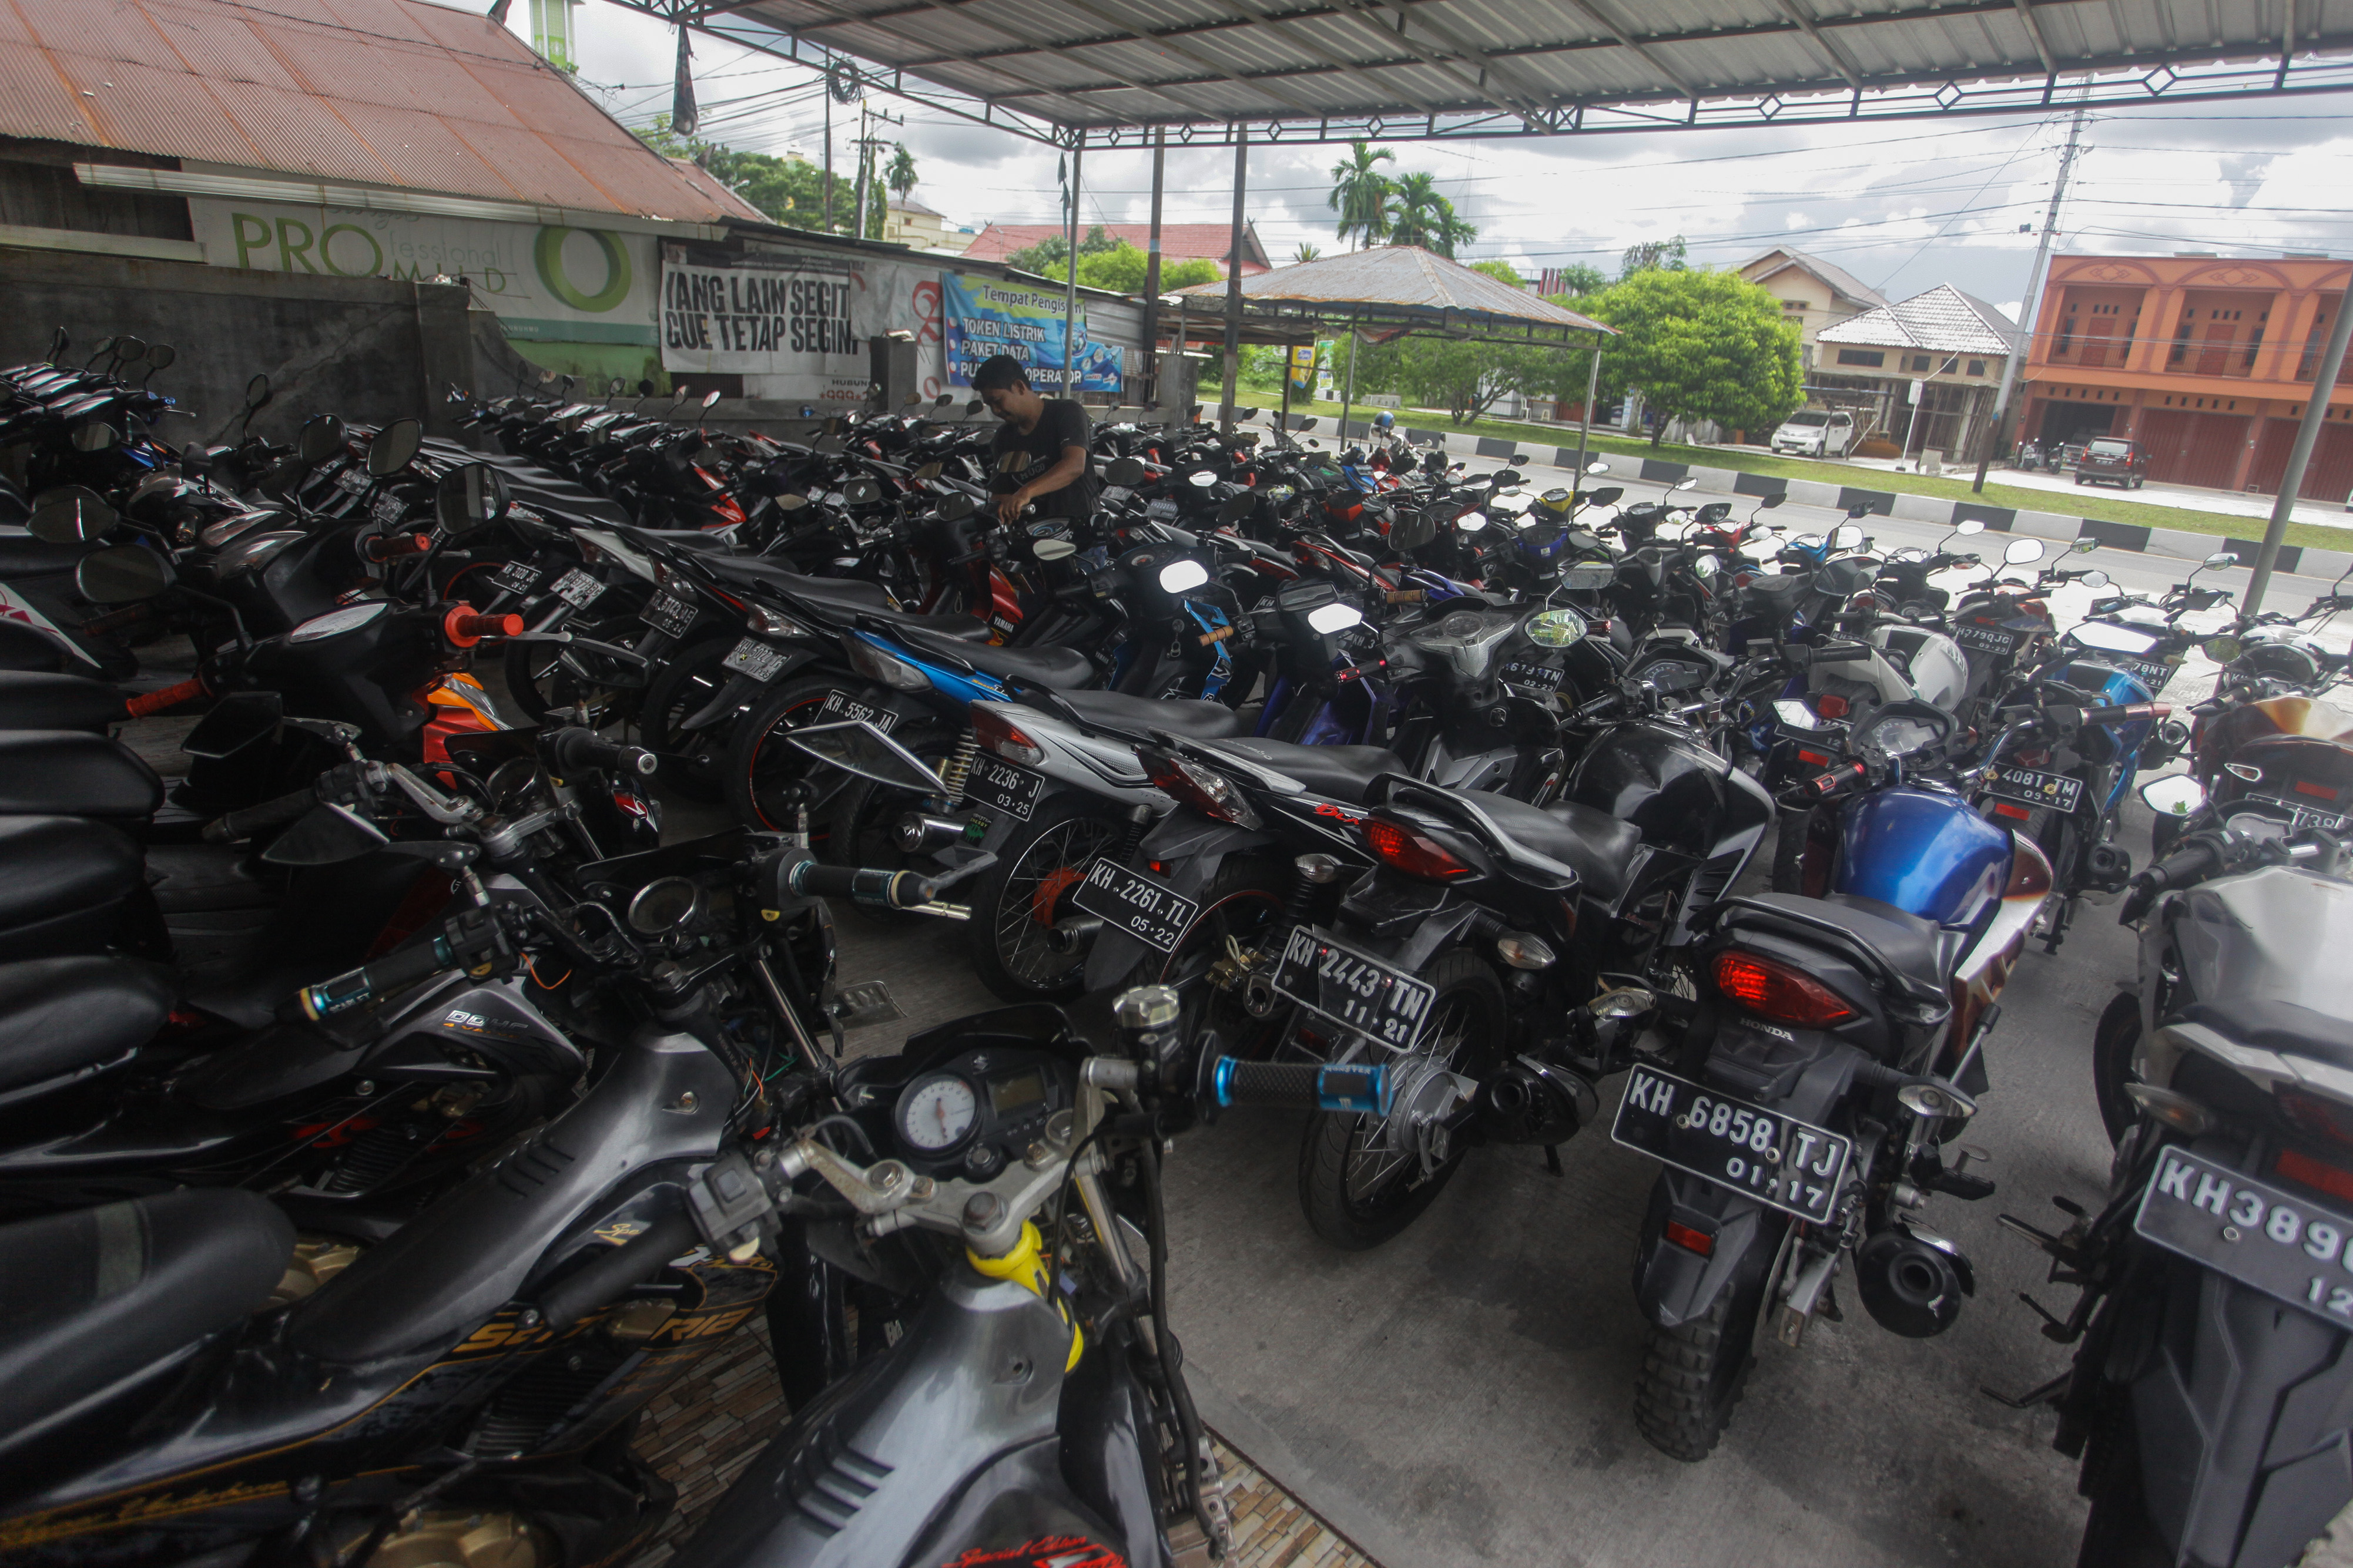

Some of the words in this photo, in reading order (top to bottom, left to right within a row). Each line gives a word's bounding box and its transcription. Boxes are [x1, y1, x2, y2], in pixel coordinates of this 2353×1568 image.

[232, 213, 383, 277] PRO
[730, 277, 786, 315] LAIN
[790, 279, 850, 318] SEGIT
[983, 284, 1028, 307] Tempat
[1031, 293, 1081, 315] Pengisn
[665, 311, 713, 350] GUE
[714, 314, 786, 351] TETAP
[963, 317, 999, 337] TOKEN
[1003, 323, 1045, 343] LISTRIK
[961, 340, 998, 356] PAKET
[1001, 344, 1030, 361] DATA
[993, 616, 1015, 633] YAMAHA
[1352, 634, 1365, 647] KH
[735, 639, 752, 654] KH
[750, 646, 773, 663] 5022
[1543, 669, 1561, 681] TN
[824, 694, 844, 713] KH
[844, 702, 874, 722] 5562
[874, 715, 893, 733] JA
[970, 756, 987, 776] KH
[987, 764, 1020, 790] 2236
[2001, 768, 2044, 788] 4081
[1089, 863, 1116, 891] KH
[1119, 879, 1162, 913] 2261
[1165, 899, 1187, 928] TL
[1286, 935, 1317, 968] KH
[1320, 948, 1380, 998] 2443
[1385, 979, 1426, 1020] TN
[1739, 1017, 1794, 1042] HONDA
[1629, 1072, 1675, 1116] KH
[1689, 1096, 1774, 1153] 6858
[1795, 1132, 1836, 1176] TJ
[2158, 1157, 2353, 1273] KH389
